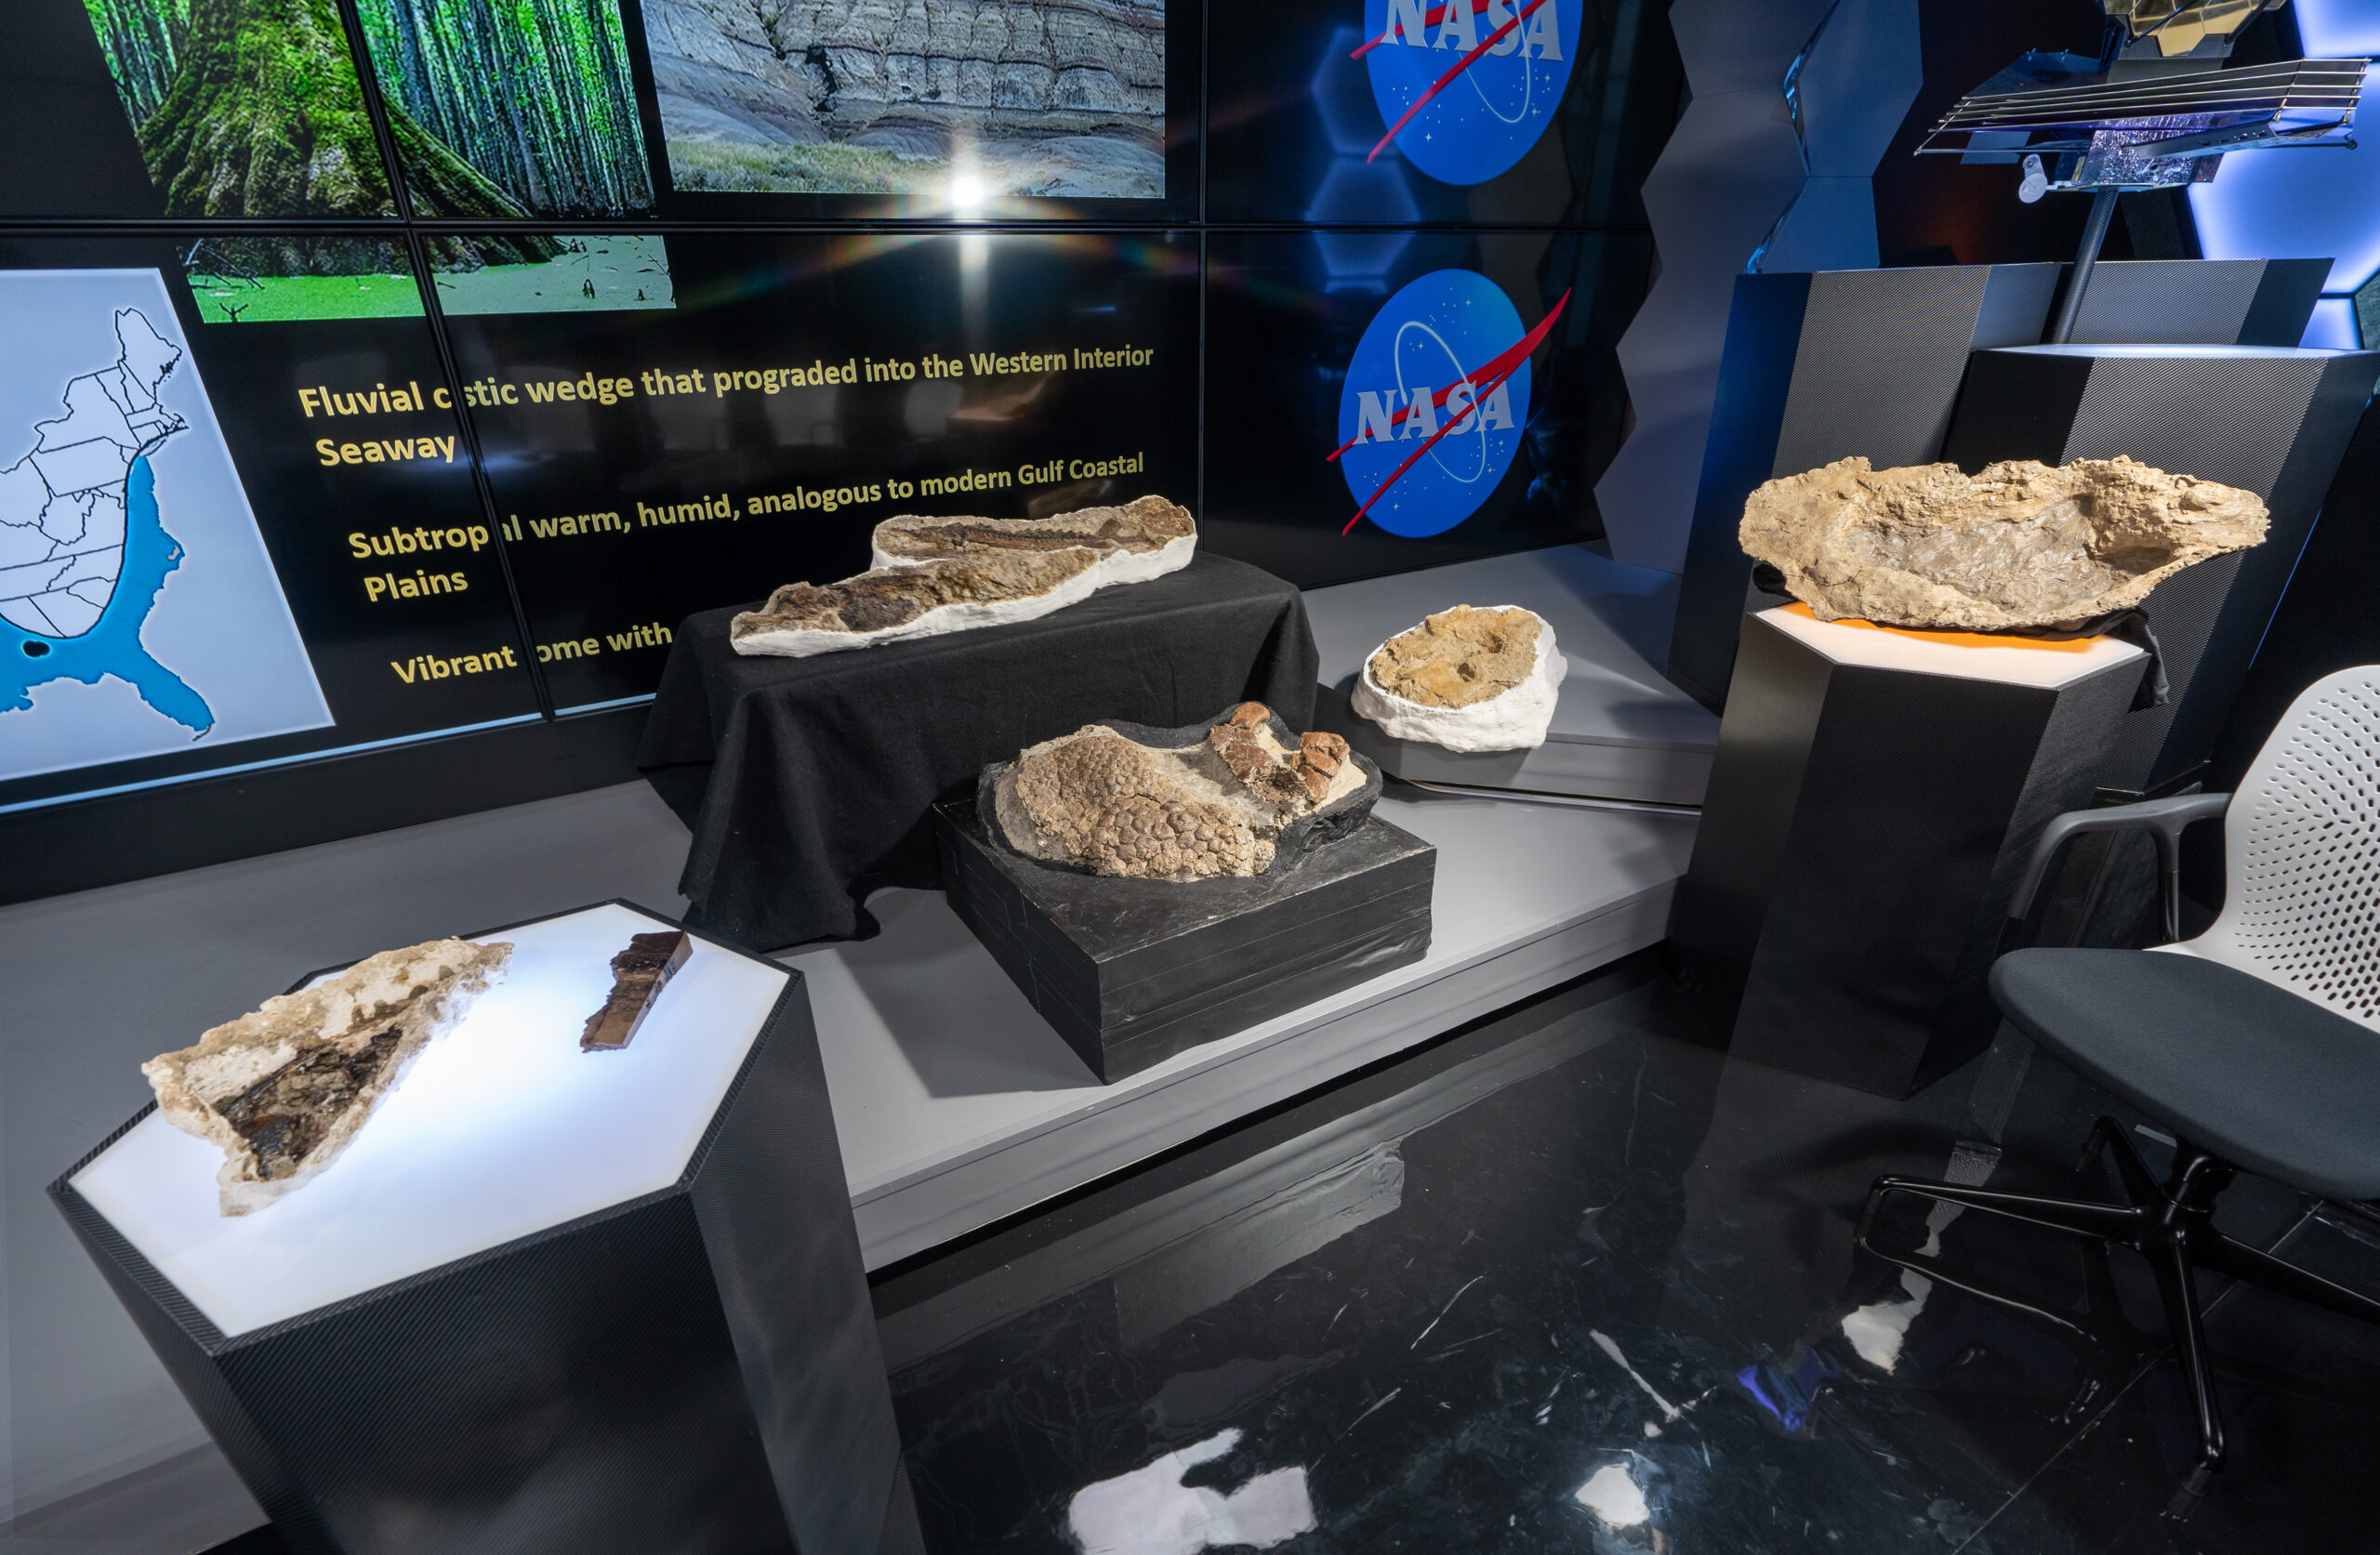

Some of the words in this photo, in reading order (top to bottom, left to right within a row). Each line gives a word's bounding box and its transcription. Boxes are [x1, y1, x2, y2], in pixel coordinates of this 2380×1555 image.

[1381, 0, 1564, 62] NASA
[298, 380, 425, 418] Fluvial
[432, 376, 520, 409] cstic
[525, 371, 635, 406] wedge
[641, 368, 706, 396] that
[713, 358, 858, 398] prograded
[864, 357, 917, 383] into
[921, 354, 964, 379] the
[969, 348, 1067, 376] Western
[1074, 345, 1155, 370] Interior
[1353, 379, 1515, 446] NASA
[316, 436, 456, 468] Seaway
[529, 511, 631, 540] warm,
[637, 494, 741, 527] humid,
[747, 484, 882, 513] analogous
[887, 478, 915, 499] to
[920, 468, 1012, 496] modern
[1018, 460, 1064, 486] Gulf
[1069, 451, 1144, 480] Coastal
[364, 570, 469, 603] Plains
[390, 645, 518, 685] Vibrant
[606, 622, 674, 652] with
